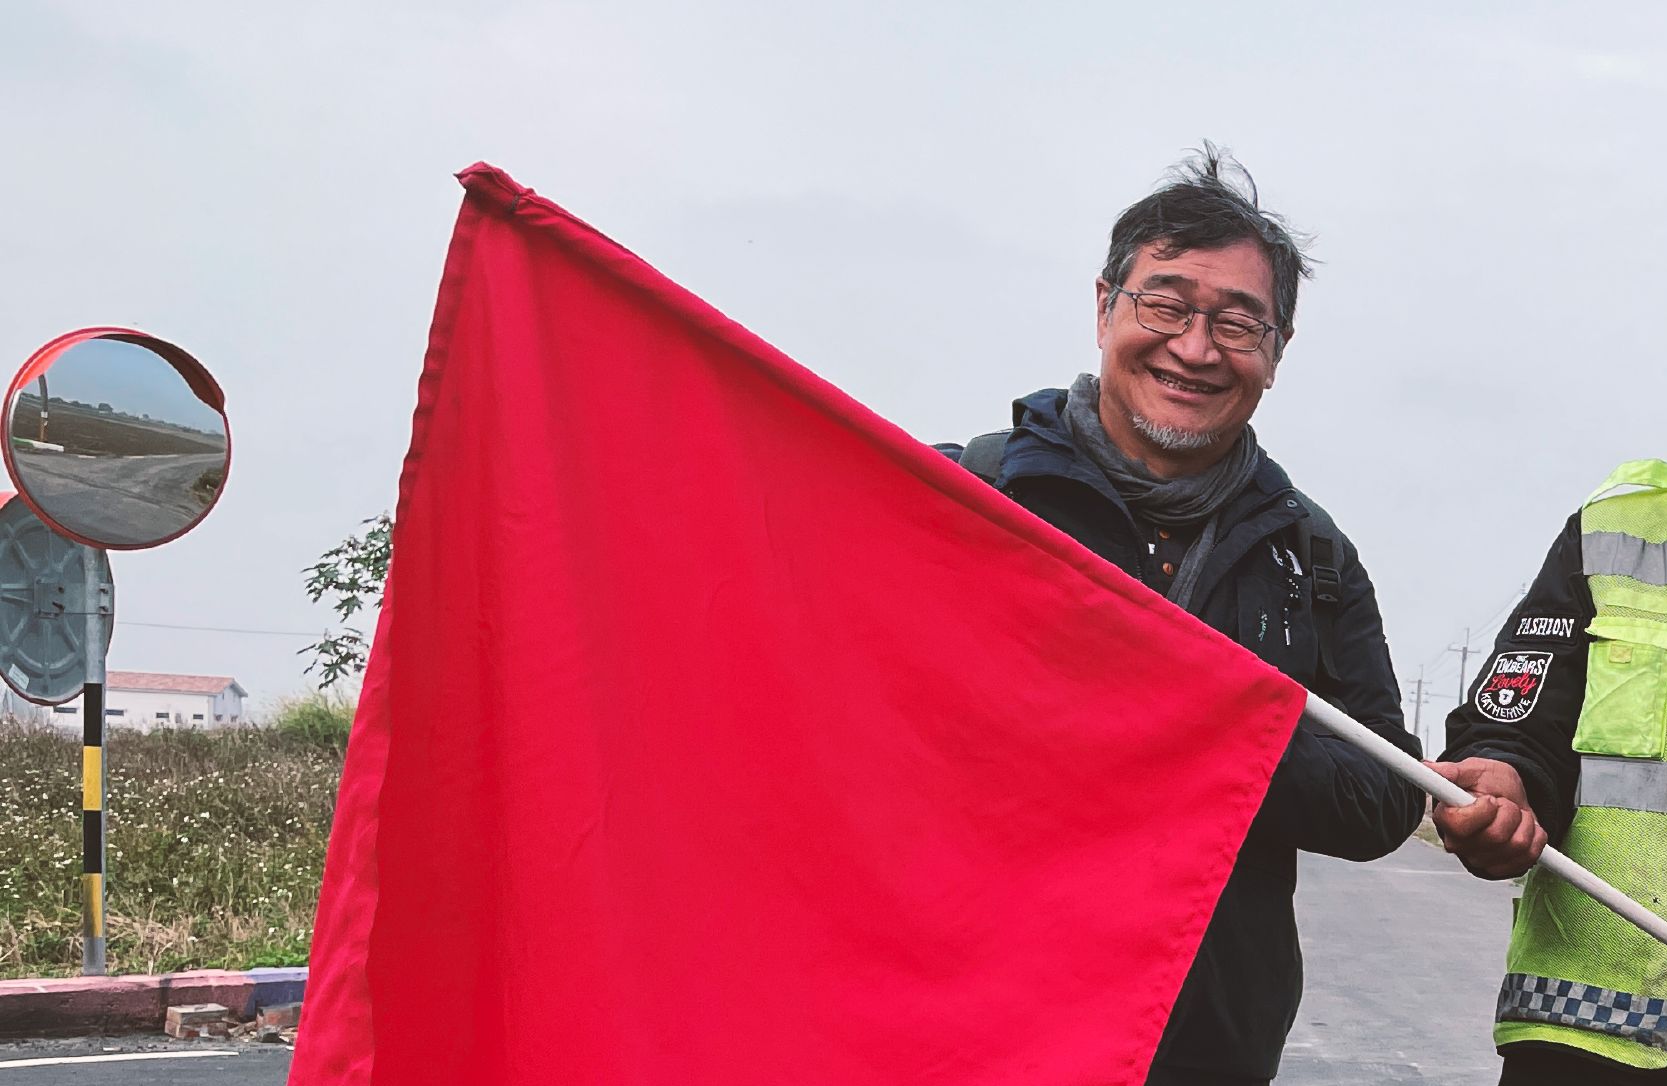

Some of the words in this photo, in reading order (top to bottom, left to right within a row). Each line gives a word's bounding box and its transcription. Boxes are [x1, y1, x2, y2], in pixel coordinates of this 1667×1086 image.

[1515, 617, 1575, 637] FASHION
[1485, 672, 1537, 695] Lovely
[1480, 692, 1532, 719] KATHERINE
